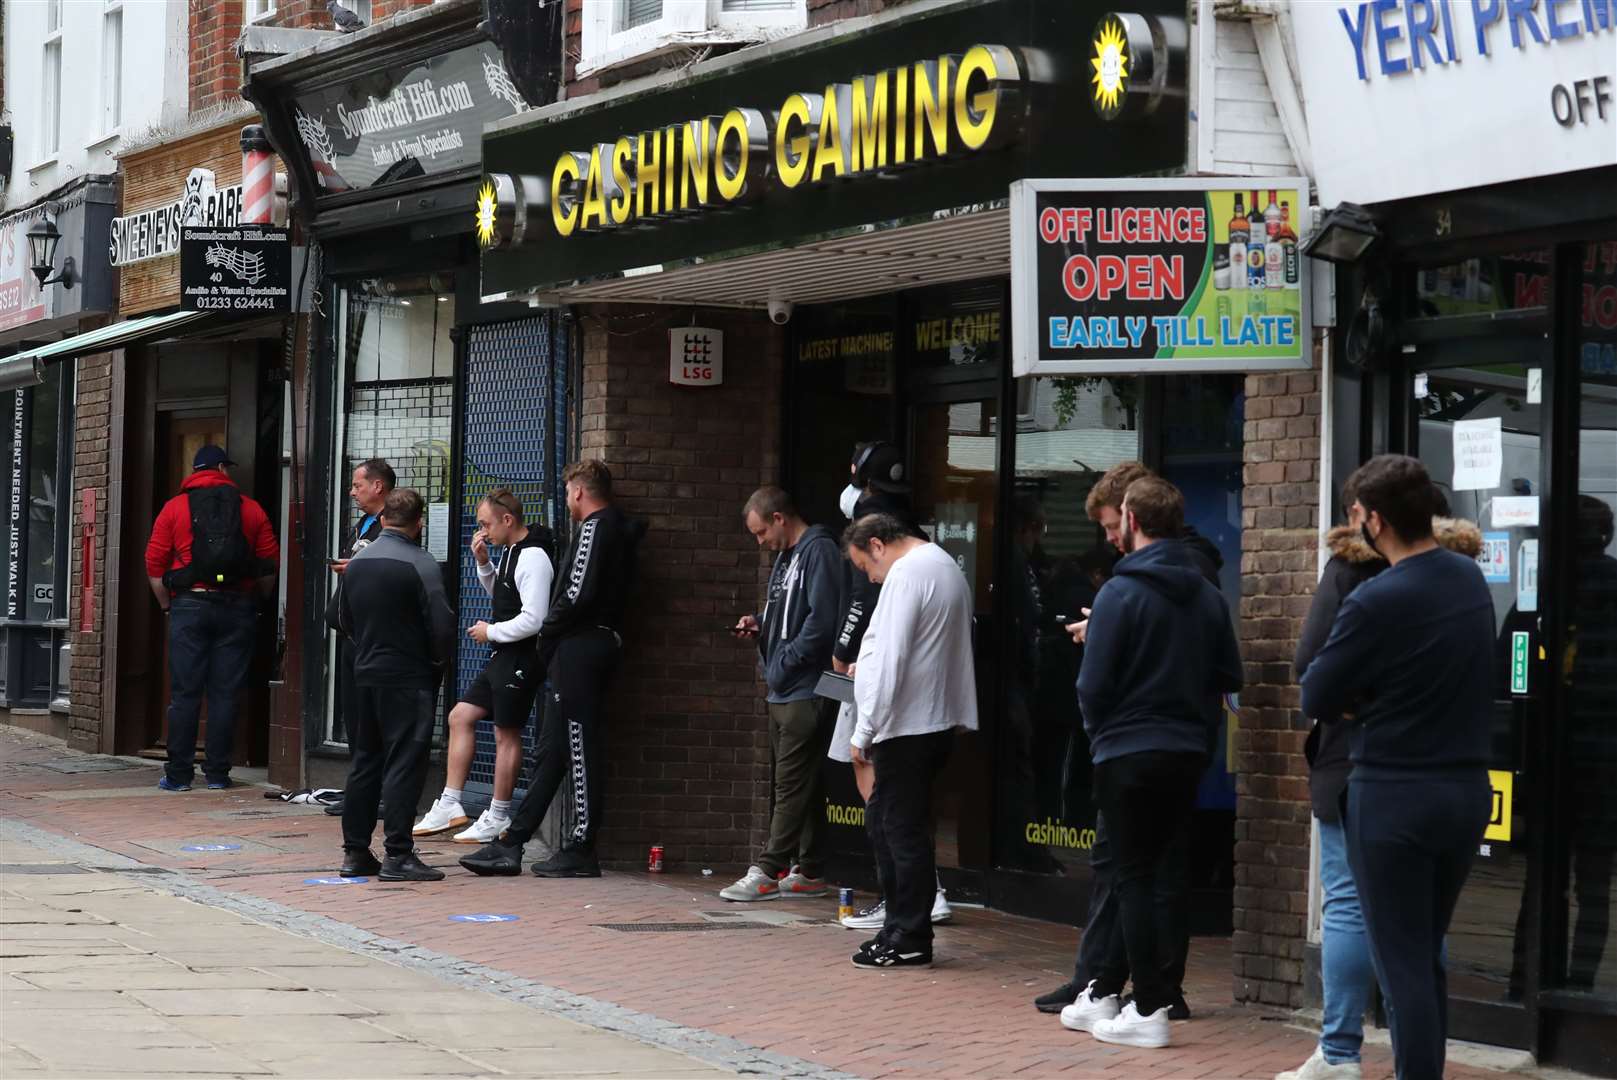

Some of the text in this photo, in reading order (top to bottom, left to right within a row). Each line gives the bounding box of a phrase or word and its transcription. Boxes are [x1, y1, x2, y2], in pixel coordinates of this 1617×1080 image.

[1338, 0, 1460, 80] YERI
[337, 78, 475, 140] Soundcraft Hifi.com
[1551, 76, 1611, 127] OFF
[422, 129, 464, 160] Specialists
[551, 44, 998, 237] CASHINO GAMING
[110, 203, 181, 265] SWEENEYS
[185, 230, 287, 241] Soundcraft Hifi.com
[1039, 206, 1206, 243] OFF LICENCE
[185, 286, 287, 296] Audio & Visual Specialists
[210, 272, 223, 283] 40
[1062, 254, 1185, 302] OPEN
[196, 297, 275, 309] 01233 624441
[799, 338, 838, 361] LATEST
[916, 312, 1000, 352] WELCOME
[1049, 314, 1295, 349] EARLY TILL LATE
[683, 367, 712, 379] LSG
[8, 386, 24, 616] POINTMENT NEEDED JUST WALK IN
[1516, 635, 1525, 689] PUSH
[1025, 816, 1097, 849] cashino.co
